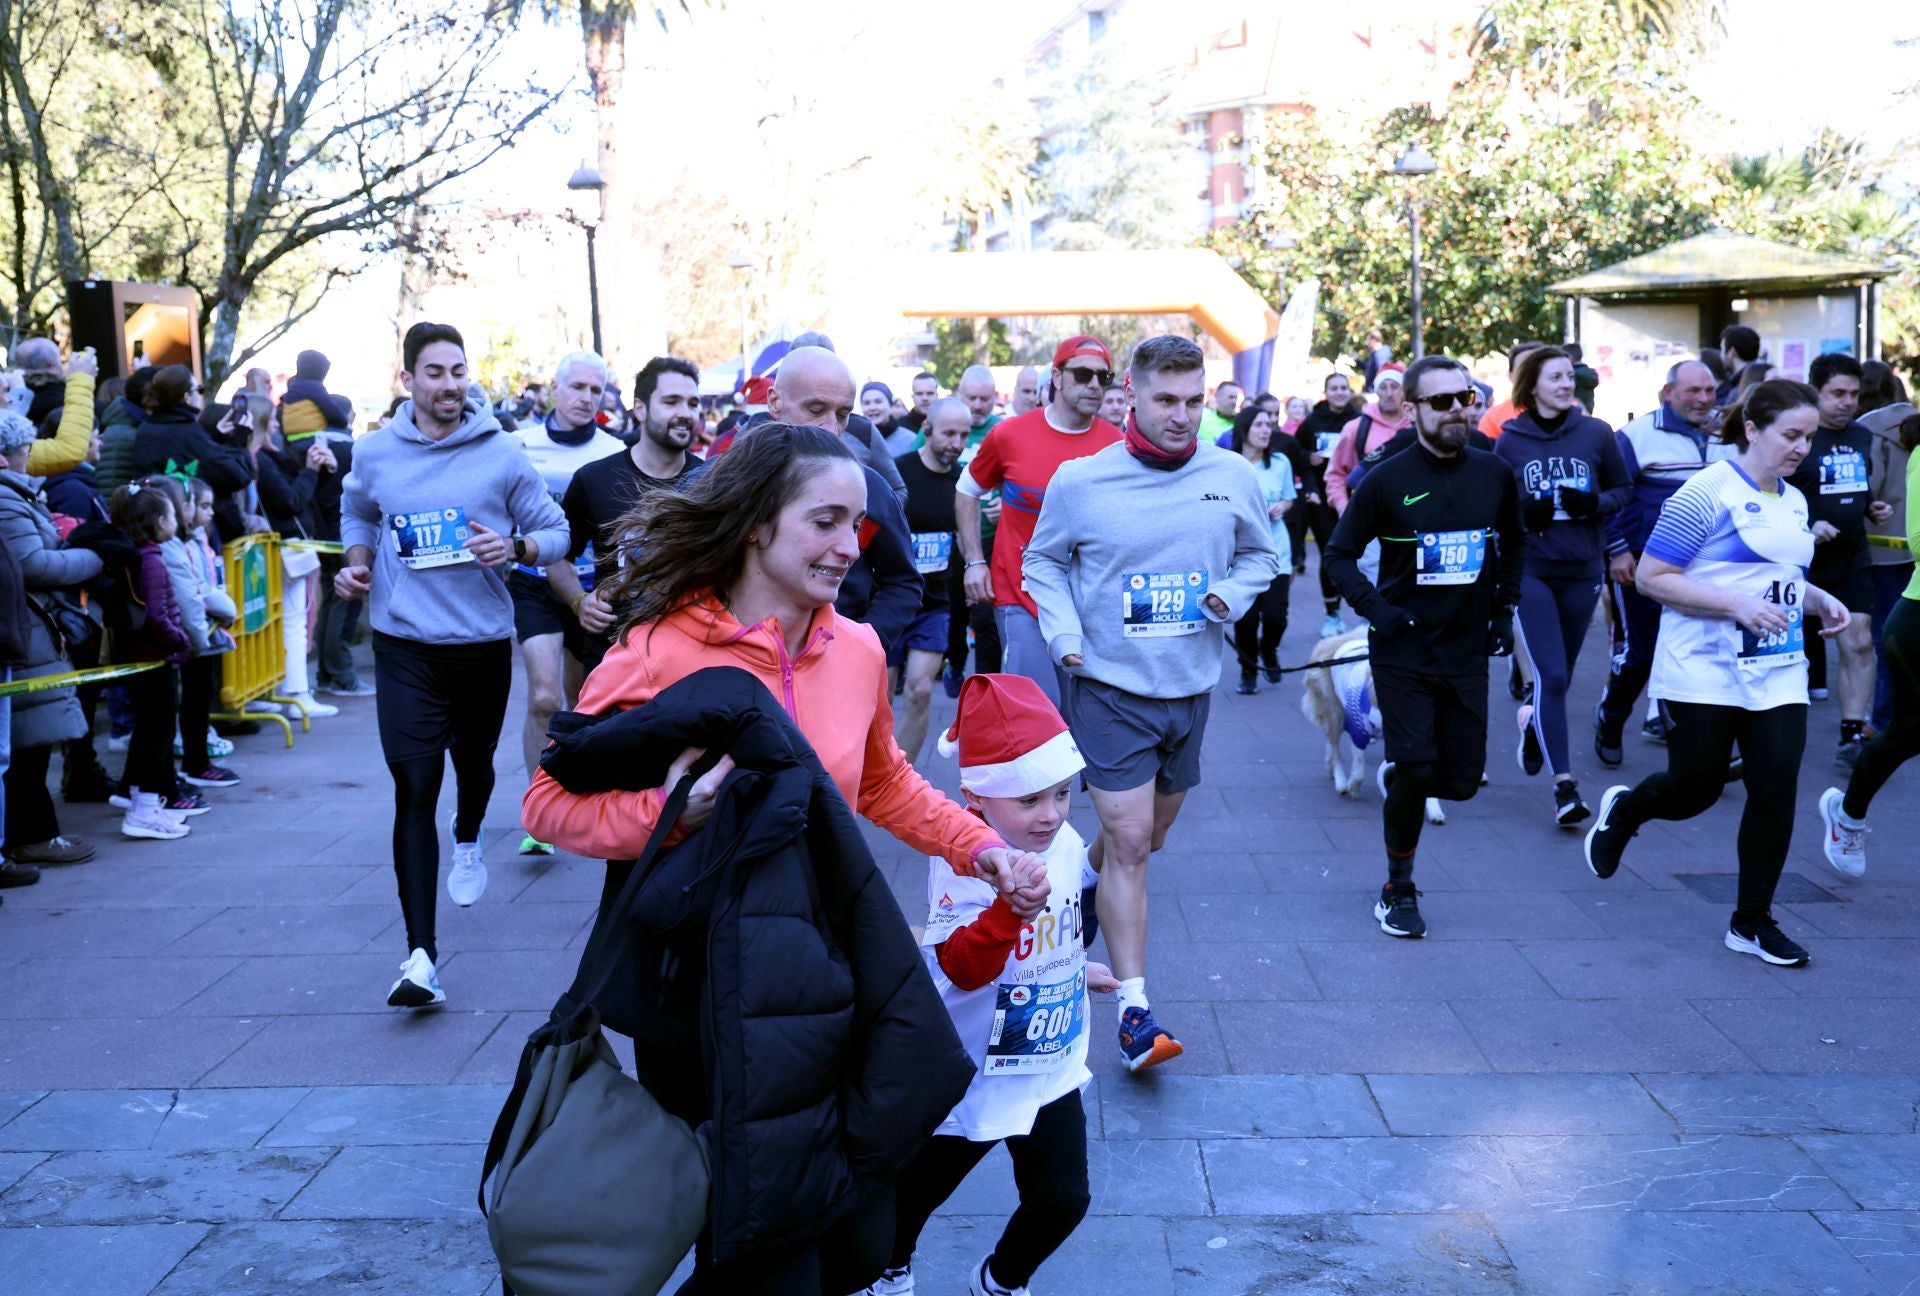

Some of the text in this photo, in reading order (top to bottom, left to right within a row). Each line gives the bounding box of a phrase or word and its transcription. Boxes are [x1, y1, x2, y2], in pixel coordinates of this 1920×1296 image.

[414, 524, 442, 548] 117
[917, 542, 939, 558] 510
[1439, 544, 1468, 566] 150
[1150, 588, 1186, 614] 129
[1152, 613, 1184, 623] MOLLY
[1014, 892, 1084, 962] GRAD
[1014, 957, 1071, 982] Villa Europea
[1026, 1000, 1074, 1041] 606
[1033, 1040, 1063, 1054] ABEL
